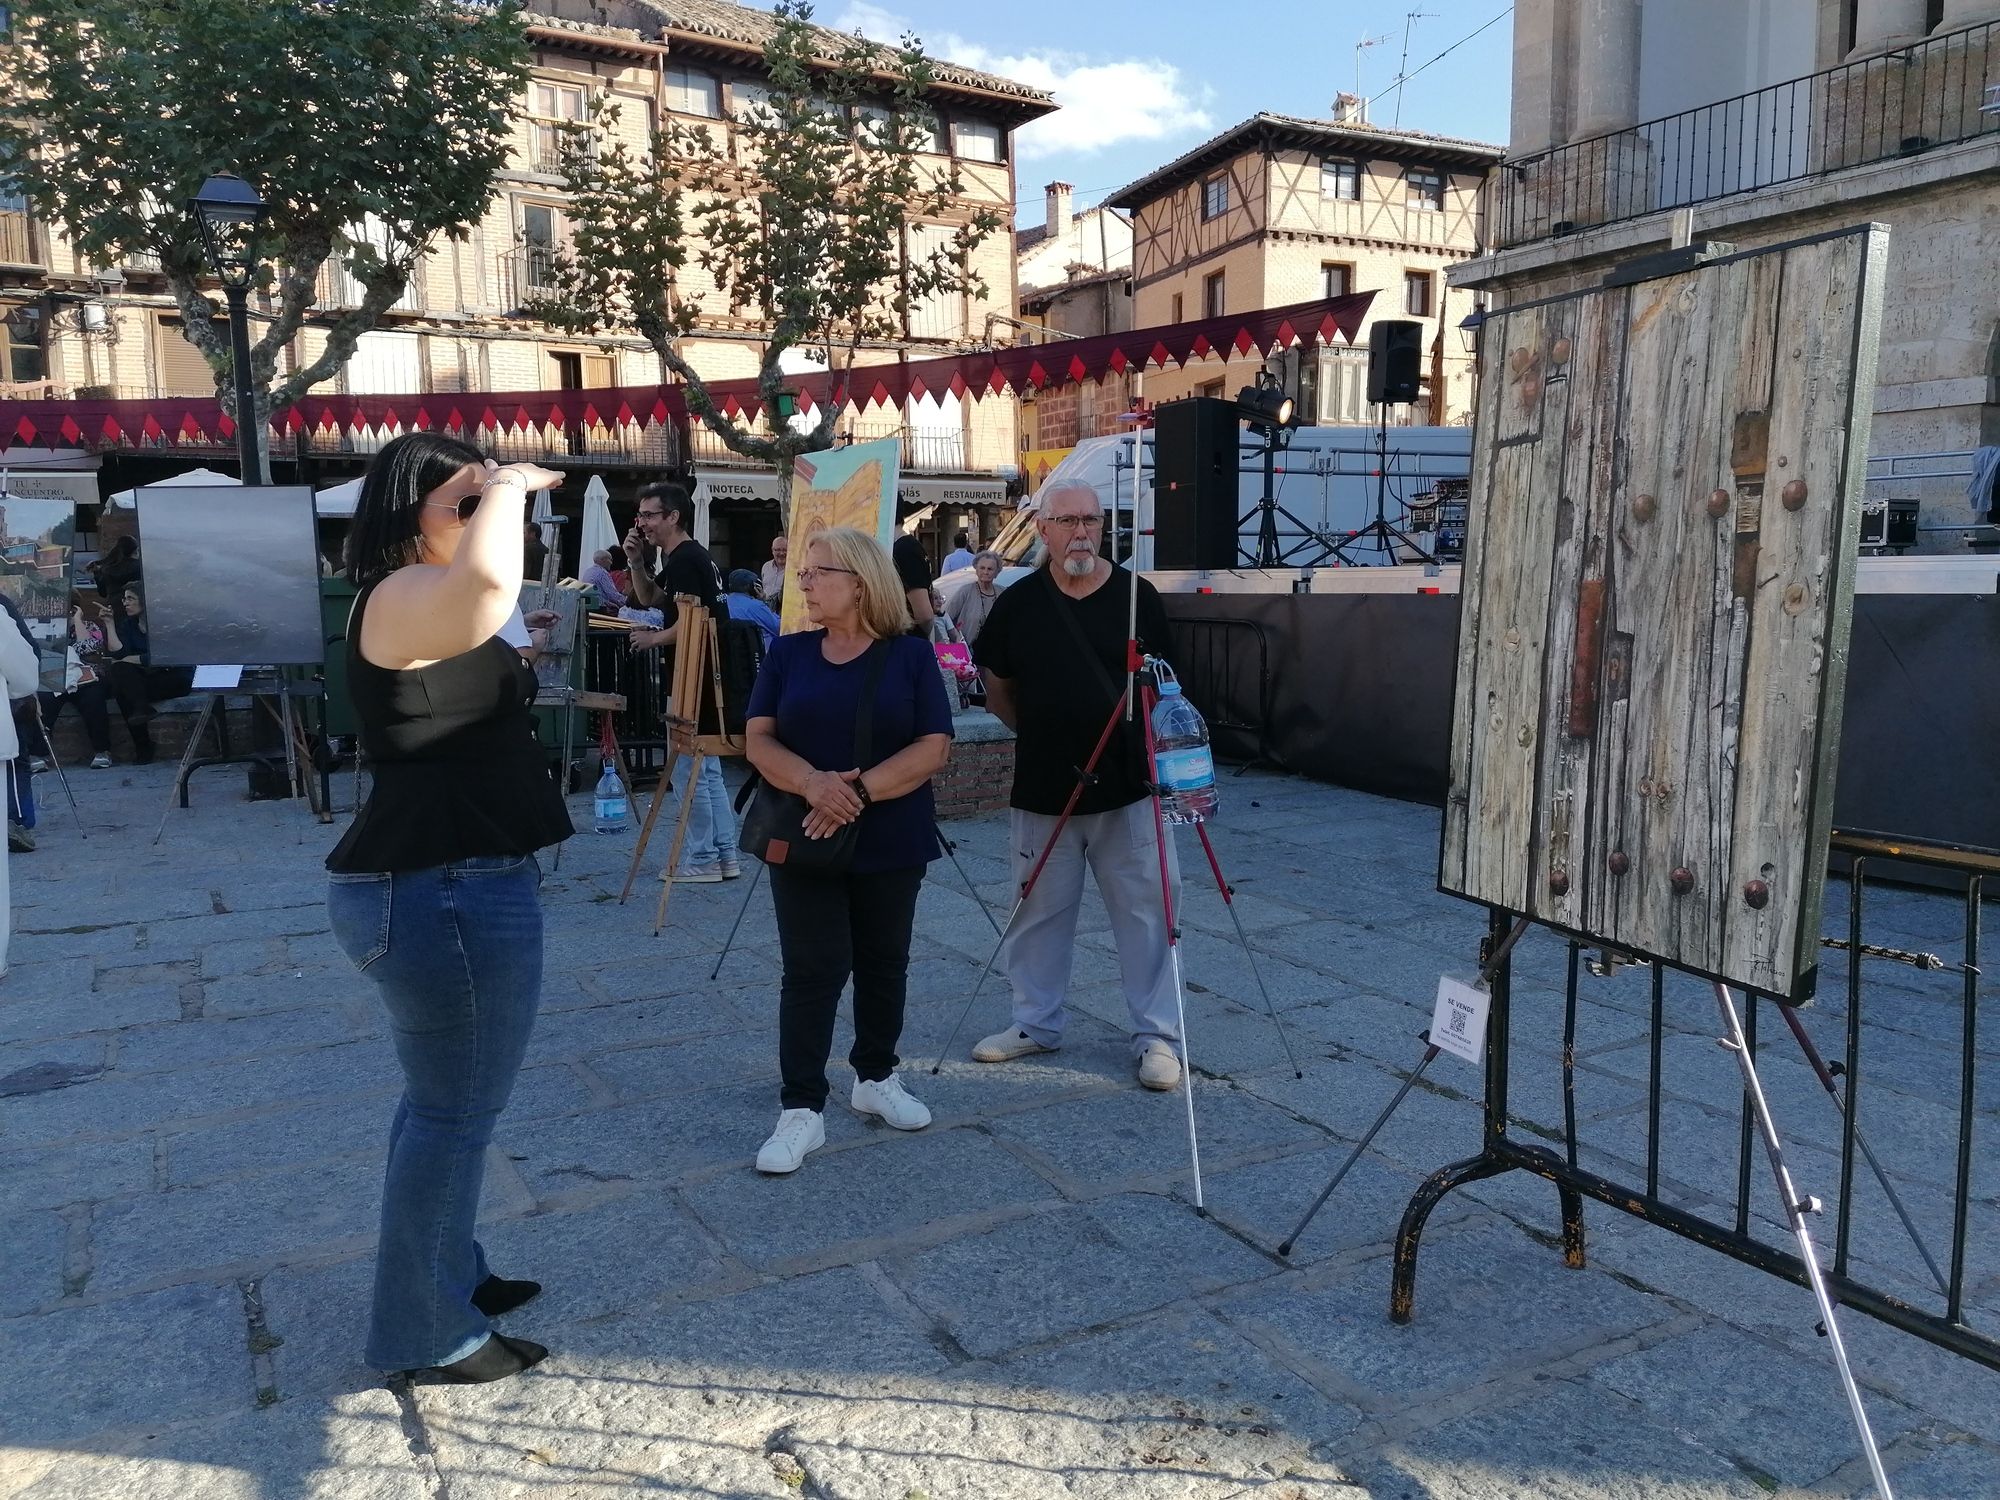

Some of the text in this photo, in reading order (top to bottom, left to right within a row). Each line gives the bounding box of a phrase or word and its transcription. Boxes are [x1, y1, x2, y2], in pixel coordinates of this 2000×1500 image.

[707, 485, 754, 494] INOTECA
[943, 491, 1002, 499] RESTAURANTE
[1455, 1001, 1475, 1014] VENDE
